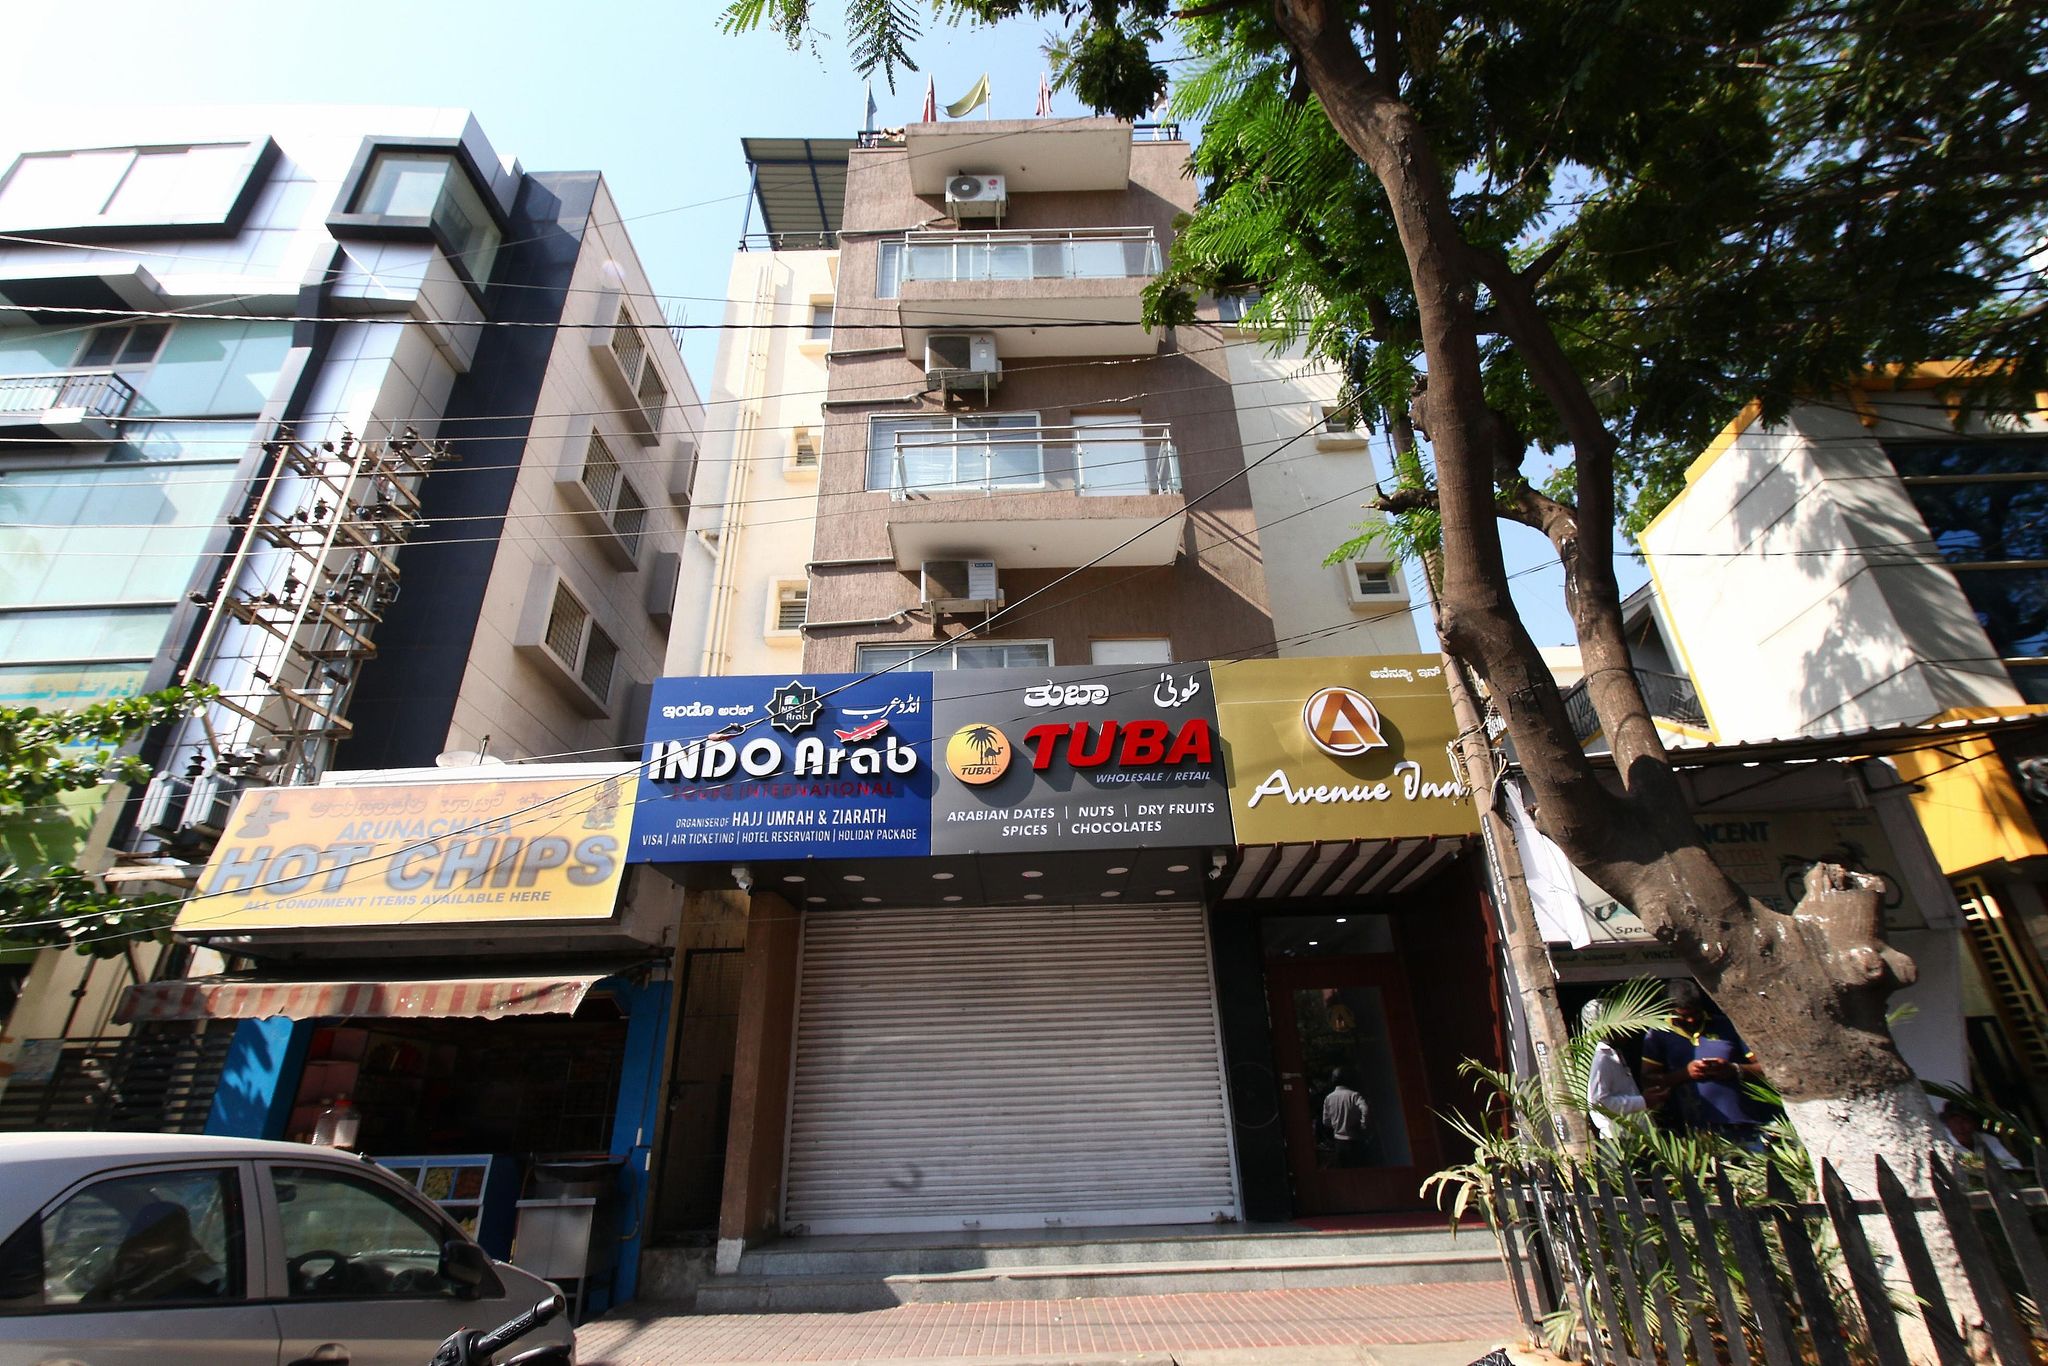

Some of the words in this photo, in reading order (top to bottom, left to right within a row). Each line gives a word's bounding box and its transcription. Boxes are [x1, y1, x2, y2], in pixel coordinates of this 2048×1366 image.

[1023, 719, 1213, 770] TUBA
[648, 737, 782, 780] INDO
[793, 736, 918, 776] Arab
[961, 766, 991, 775] TUBA
[1096, 772, 1162, 783] WHOLESALE
[1175, 771, 1211, 780] RETAIL
[740, 781, 895, 798] INTERNATIONAL
[1248, 769, 1390, 808] Avenue
[732, 811, 763, 826] HAJJ
[767, 810, 814, 826] UMRAH
[818, 809, 827, 824] &
[832, 808, 887, 825] ZIARATH
[947, 809, 1008, 822] ARABIAN
[1013, 808, 1055, 819] DATES
[1078, 806, 1115, 818] NUTS
[1138, 804, 1167, 816] DRY
[1169, 802, 1215, 815] FRUITS
[336, 816, 512, 840] ARUNACHALA
[642, 834, 663, 845] VISA
[671, 834, 686, 844] AIR
[689, 832, 734, 844] TICKETING
[742, 831, 769, 843] HOTEL
[771, 830, 830, 842] RESERVATION
[838, 829, 874, 841] HOLIDAY
[876, 828, 917, 840] PACKAGE
[1001, 825, 1048, 837] SPICES
[1071, 821, 1162, 835] CHOCOLATES
[1696, 821, 1768, 843] NCENT
[1711, 849, 1766, 863] OTOR
[203, 843, 377, 898] HOT
[385, 834, 619, 892] CHIPS
[243, 900, 270, 911] ALL
[275, 896, 365, 910] CONDIMENT
[375, 894, 416, 906] ITEMS
[420, 892, 504, 905] AVAILABLE
[508, 890, 552, 902] HERE
[1642, 950, 1676, 959] VINCE
